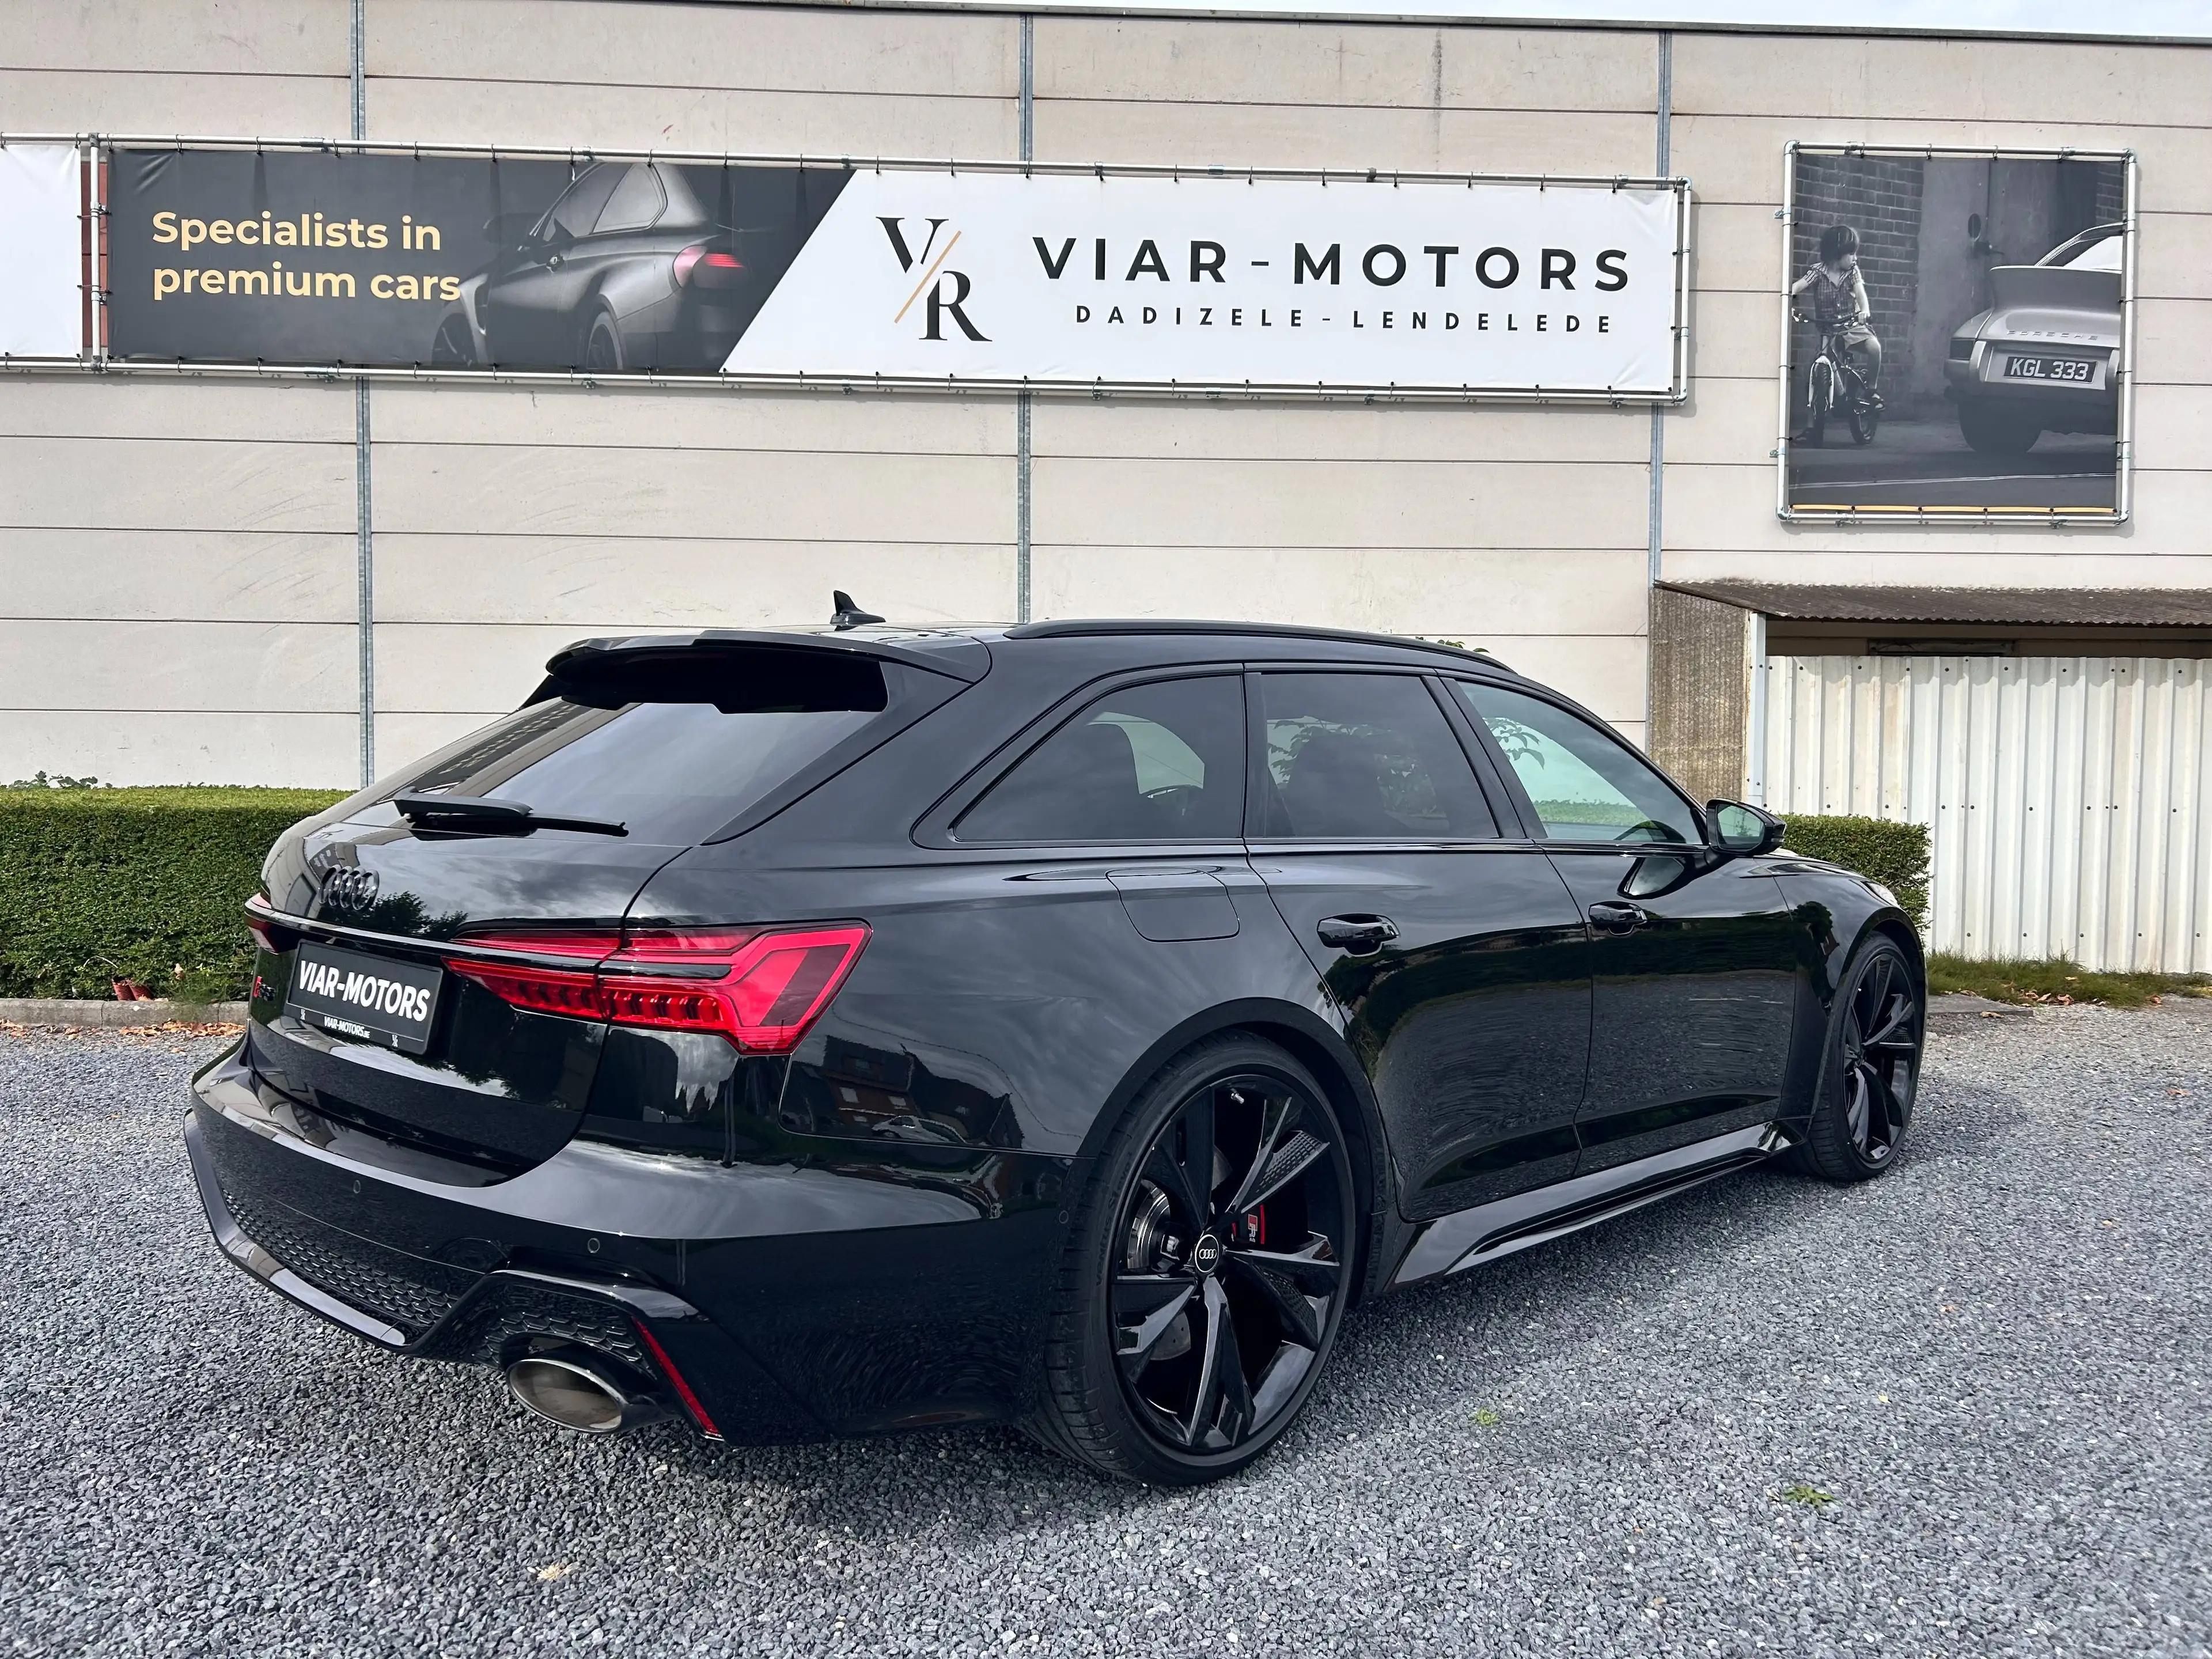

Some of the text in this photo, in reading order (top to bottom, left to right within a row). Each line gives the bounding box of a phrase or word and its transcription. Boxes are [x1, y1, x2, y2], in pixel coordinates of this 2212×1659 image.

[152, 210, 441, 251] Specialists in
[154, 261, 461, 301] premium cars
[2010, 358, 2089, 380] KGL 333
[299, 960, 430, 1022] VIAR-MOTORS
